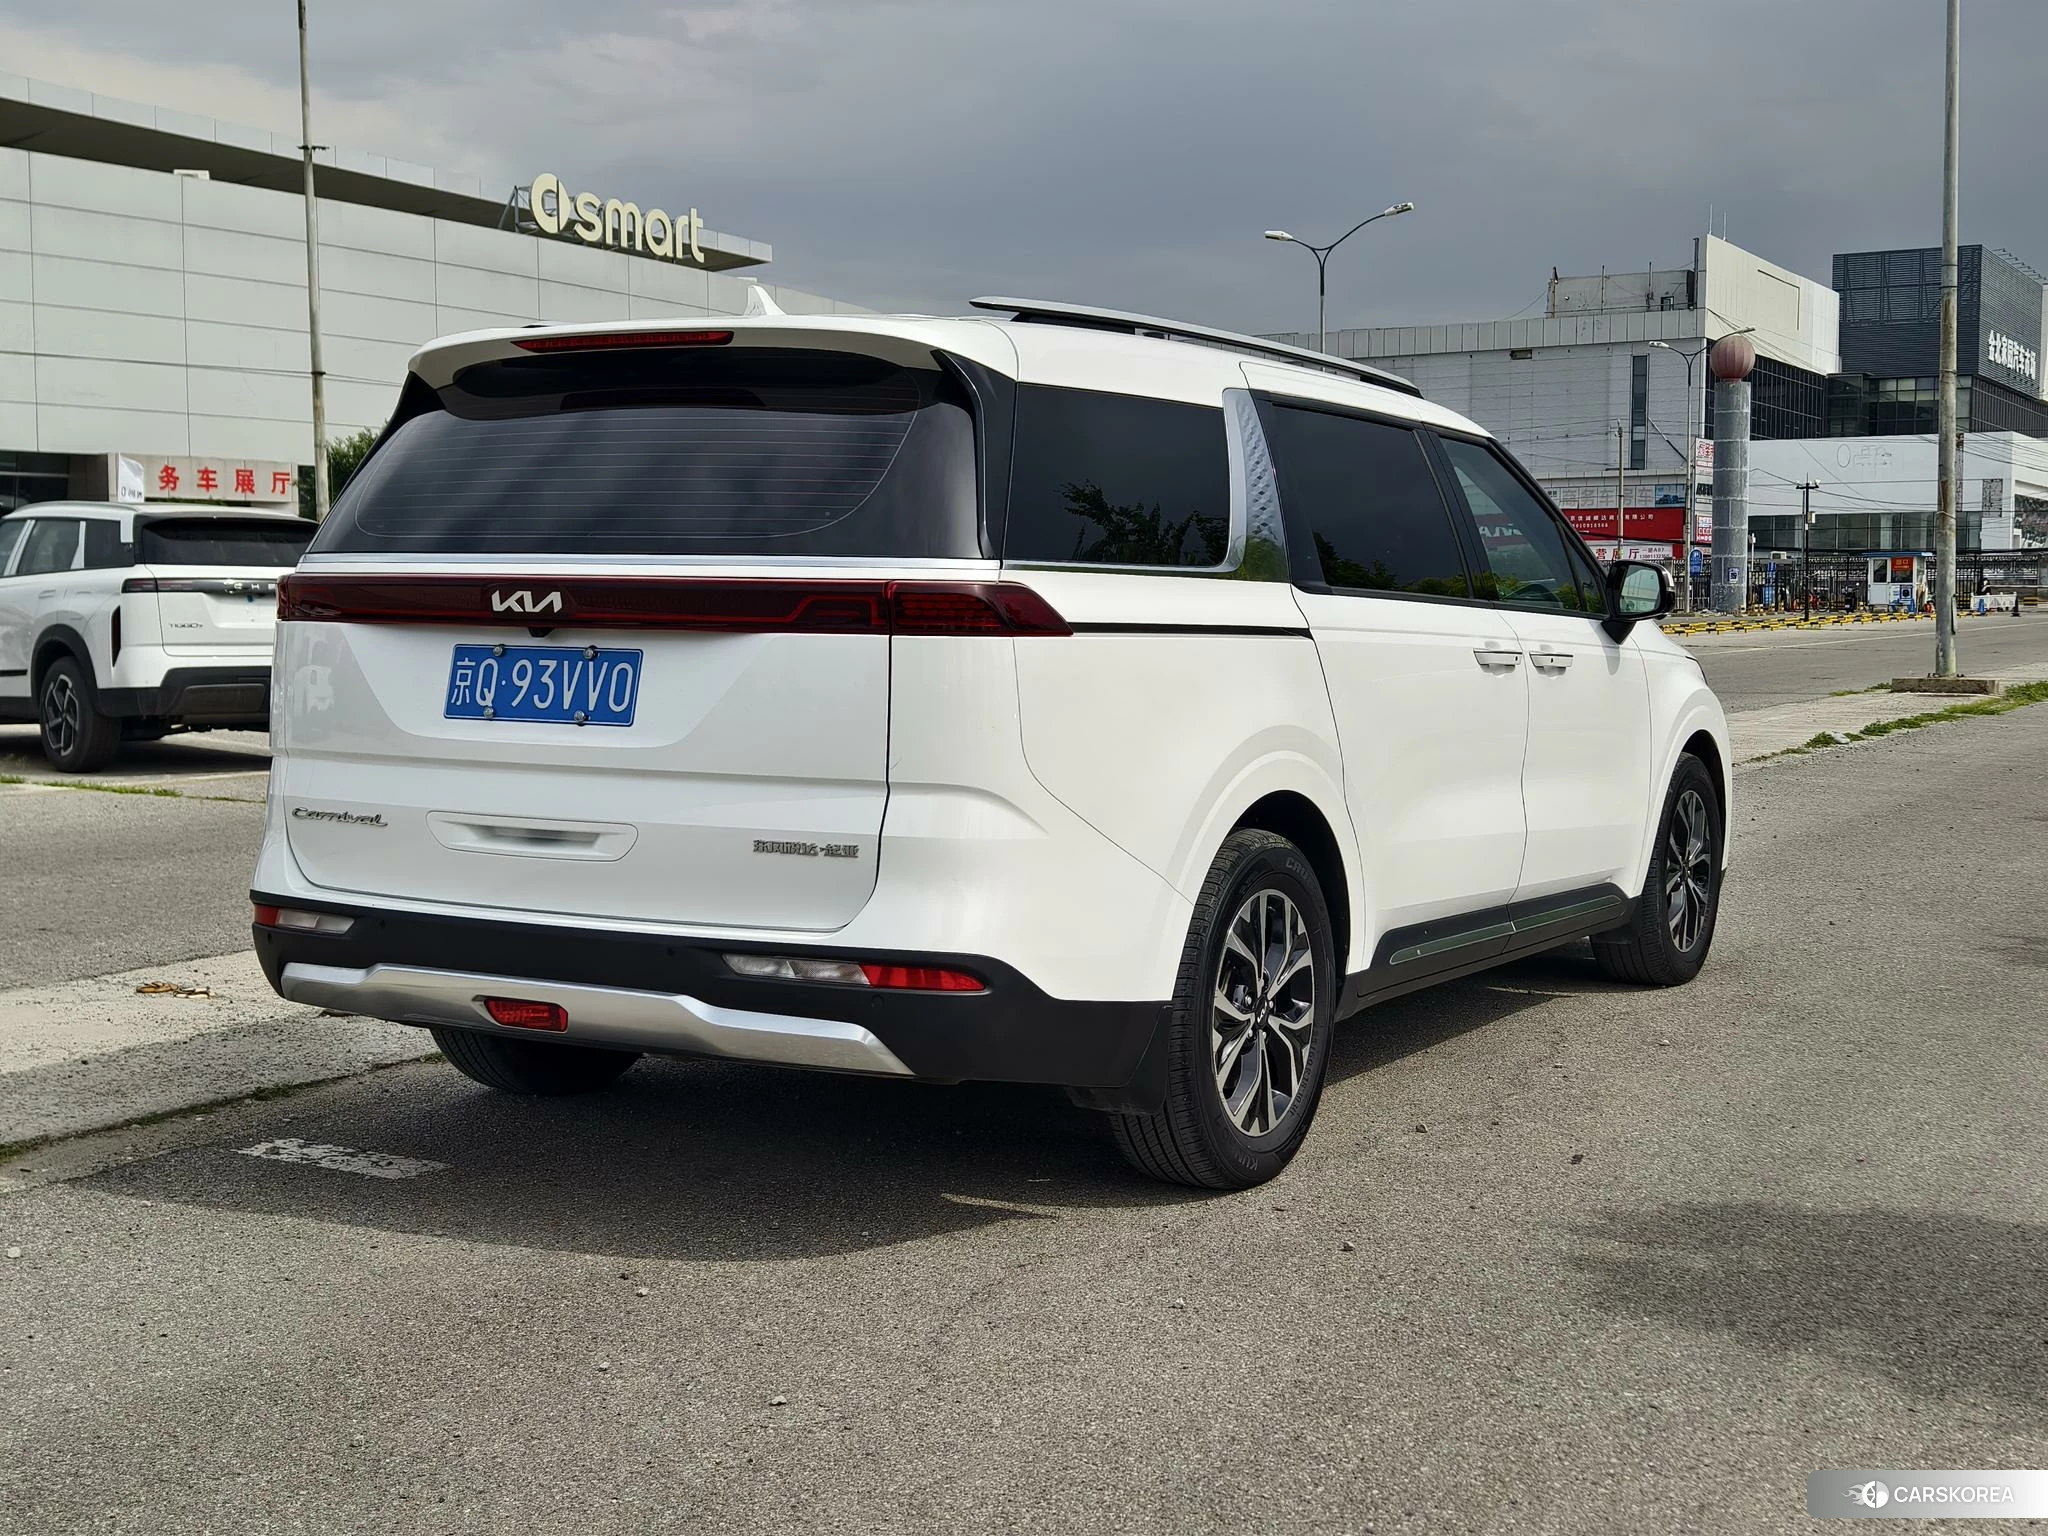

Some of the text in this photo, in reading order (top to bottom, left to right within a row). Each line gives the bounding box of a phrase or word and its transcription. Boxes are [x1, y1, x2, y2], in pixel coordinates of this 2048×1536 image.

[574, 191, 705, 263] smart
[158, 465, 291, 495] 务车展厅
[491, 589, 563, 613] KIA
[291, 807, 389, 827] Carnival
